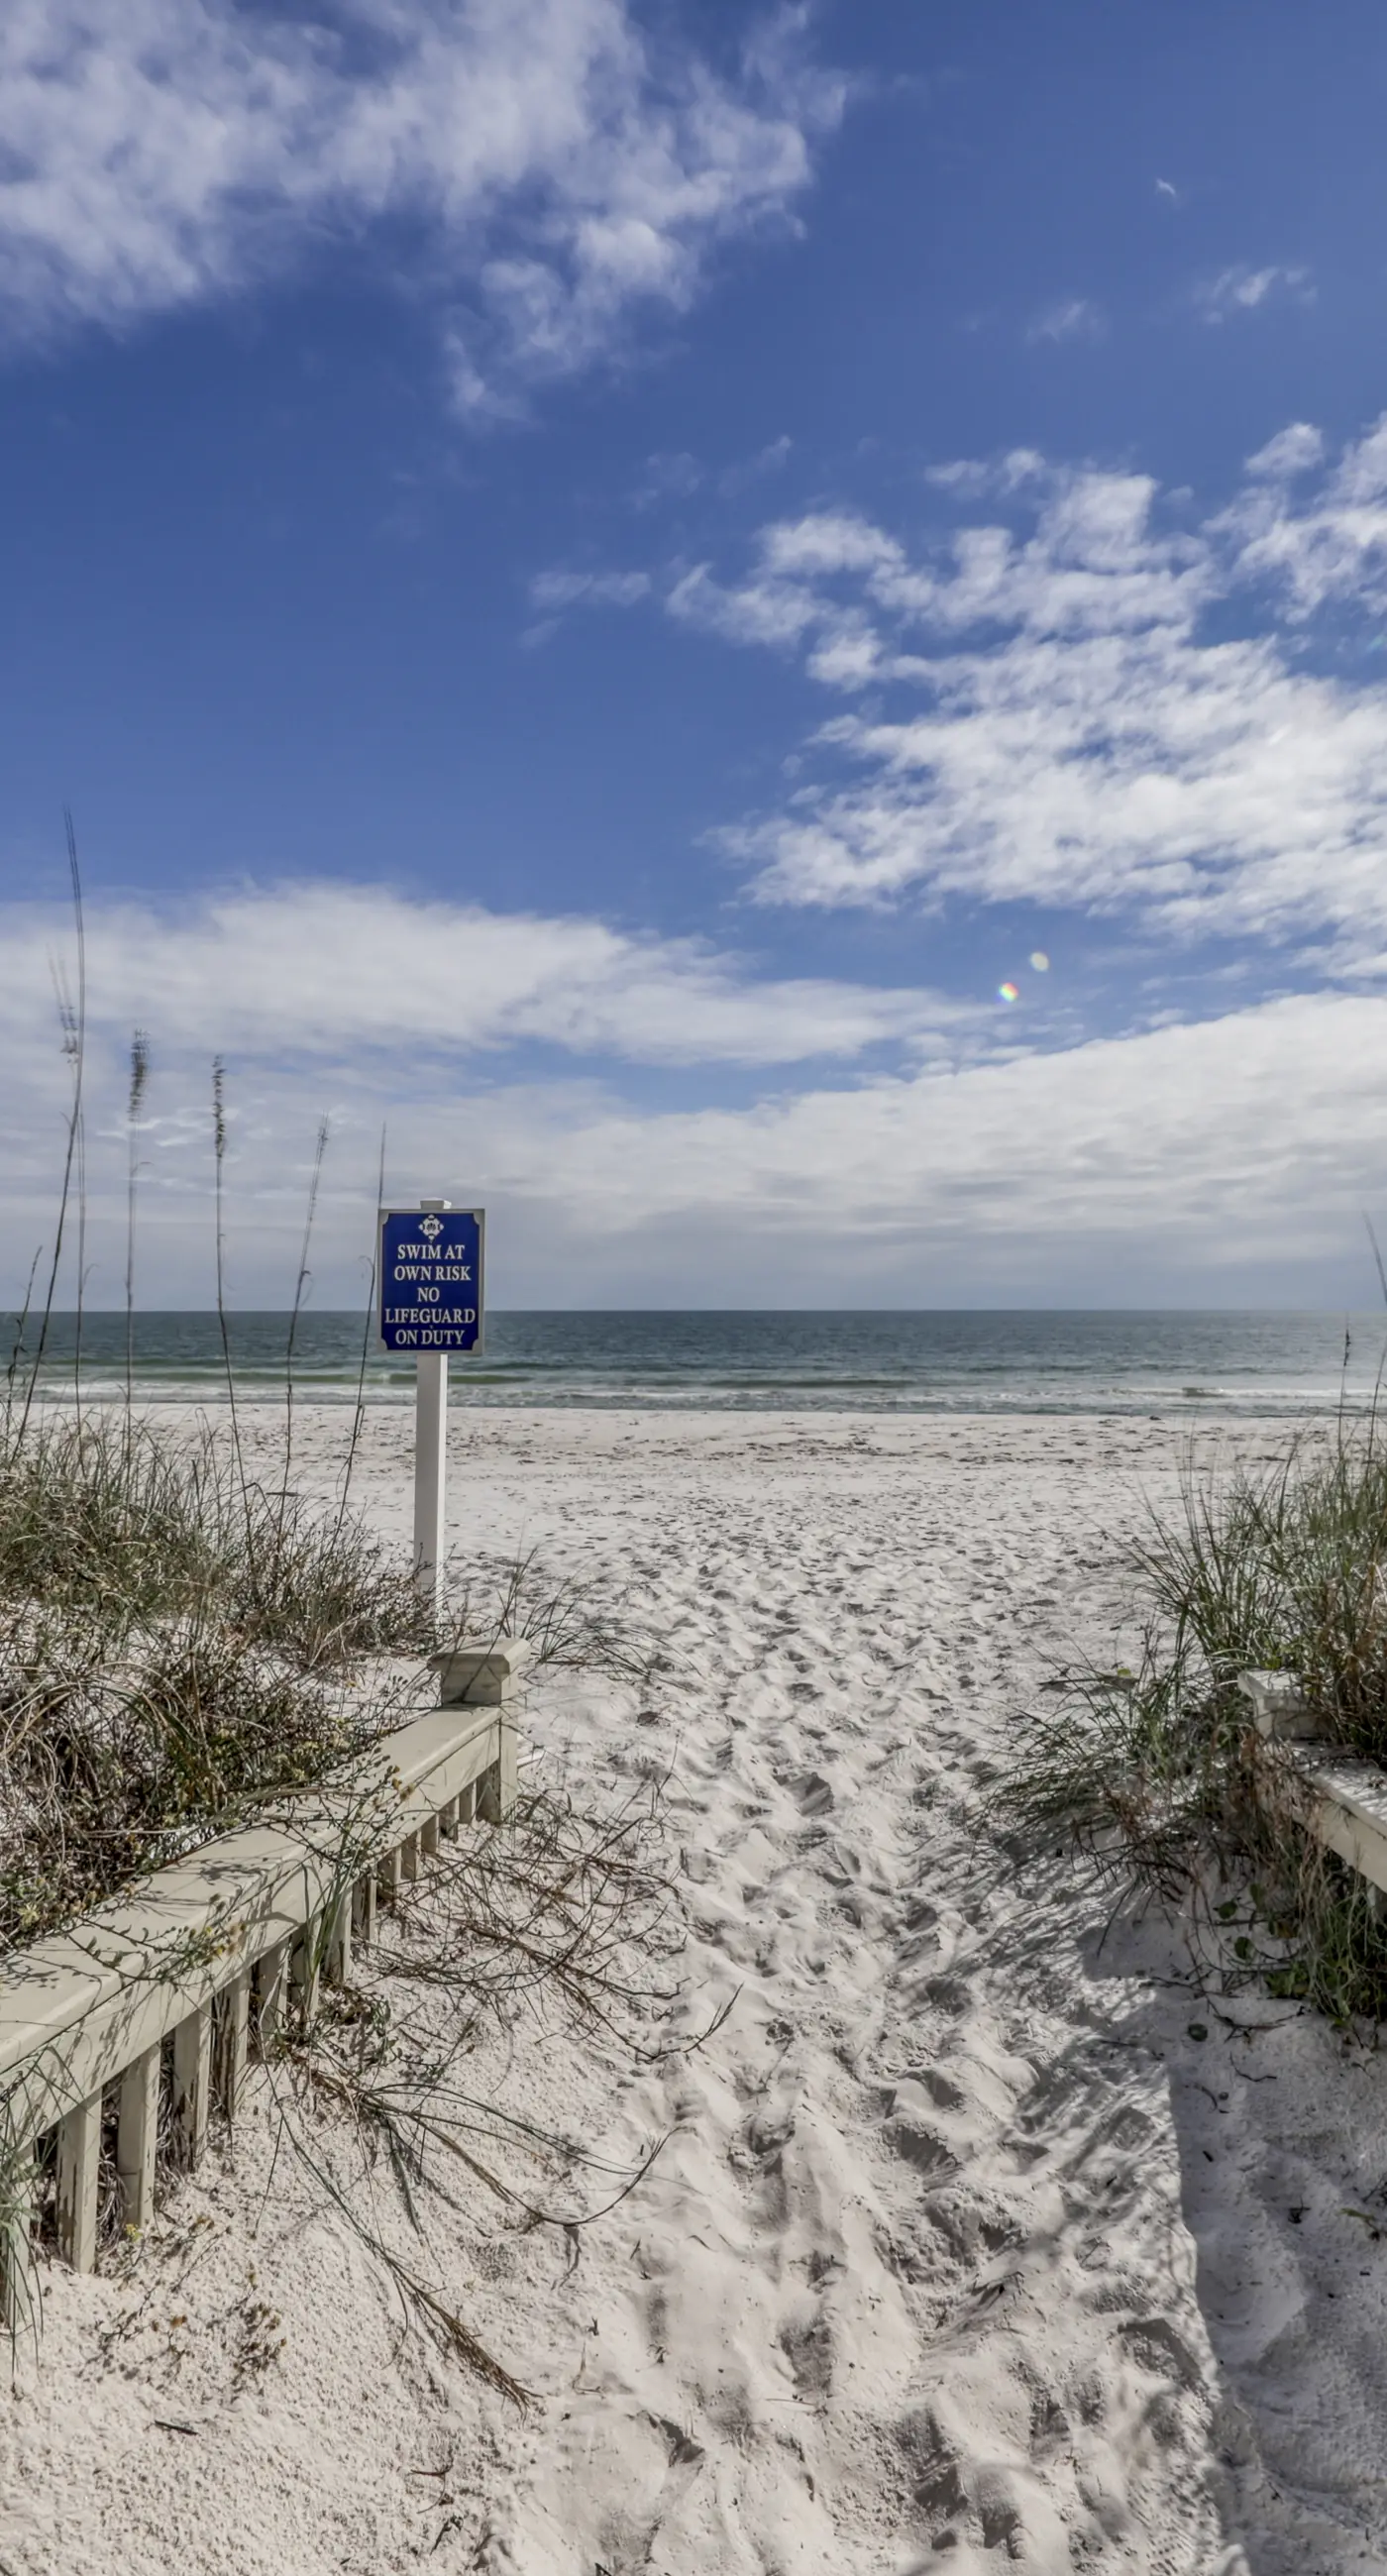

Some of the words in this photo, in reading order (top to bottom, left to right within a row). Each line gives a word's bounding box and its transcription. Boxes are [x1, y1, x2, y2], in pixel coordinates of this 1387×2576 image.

[397, 1244, 441, 1259] SWIM
[444, 1244, 466, 1259] AT
[394, 1265, 432, 1281] OWN
[435, 1265, 472, 1281] RISK
[417, 1287, 440, 1302] NO
[384, 1308, 476, 1324] LIFEGUARD
[395, 1330, 419, 1344] ON
[421, 1330, 465, 1344] DUTY
